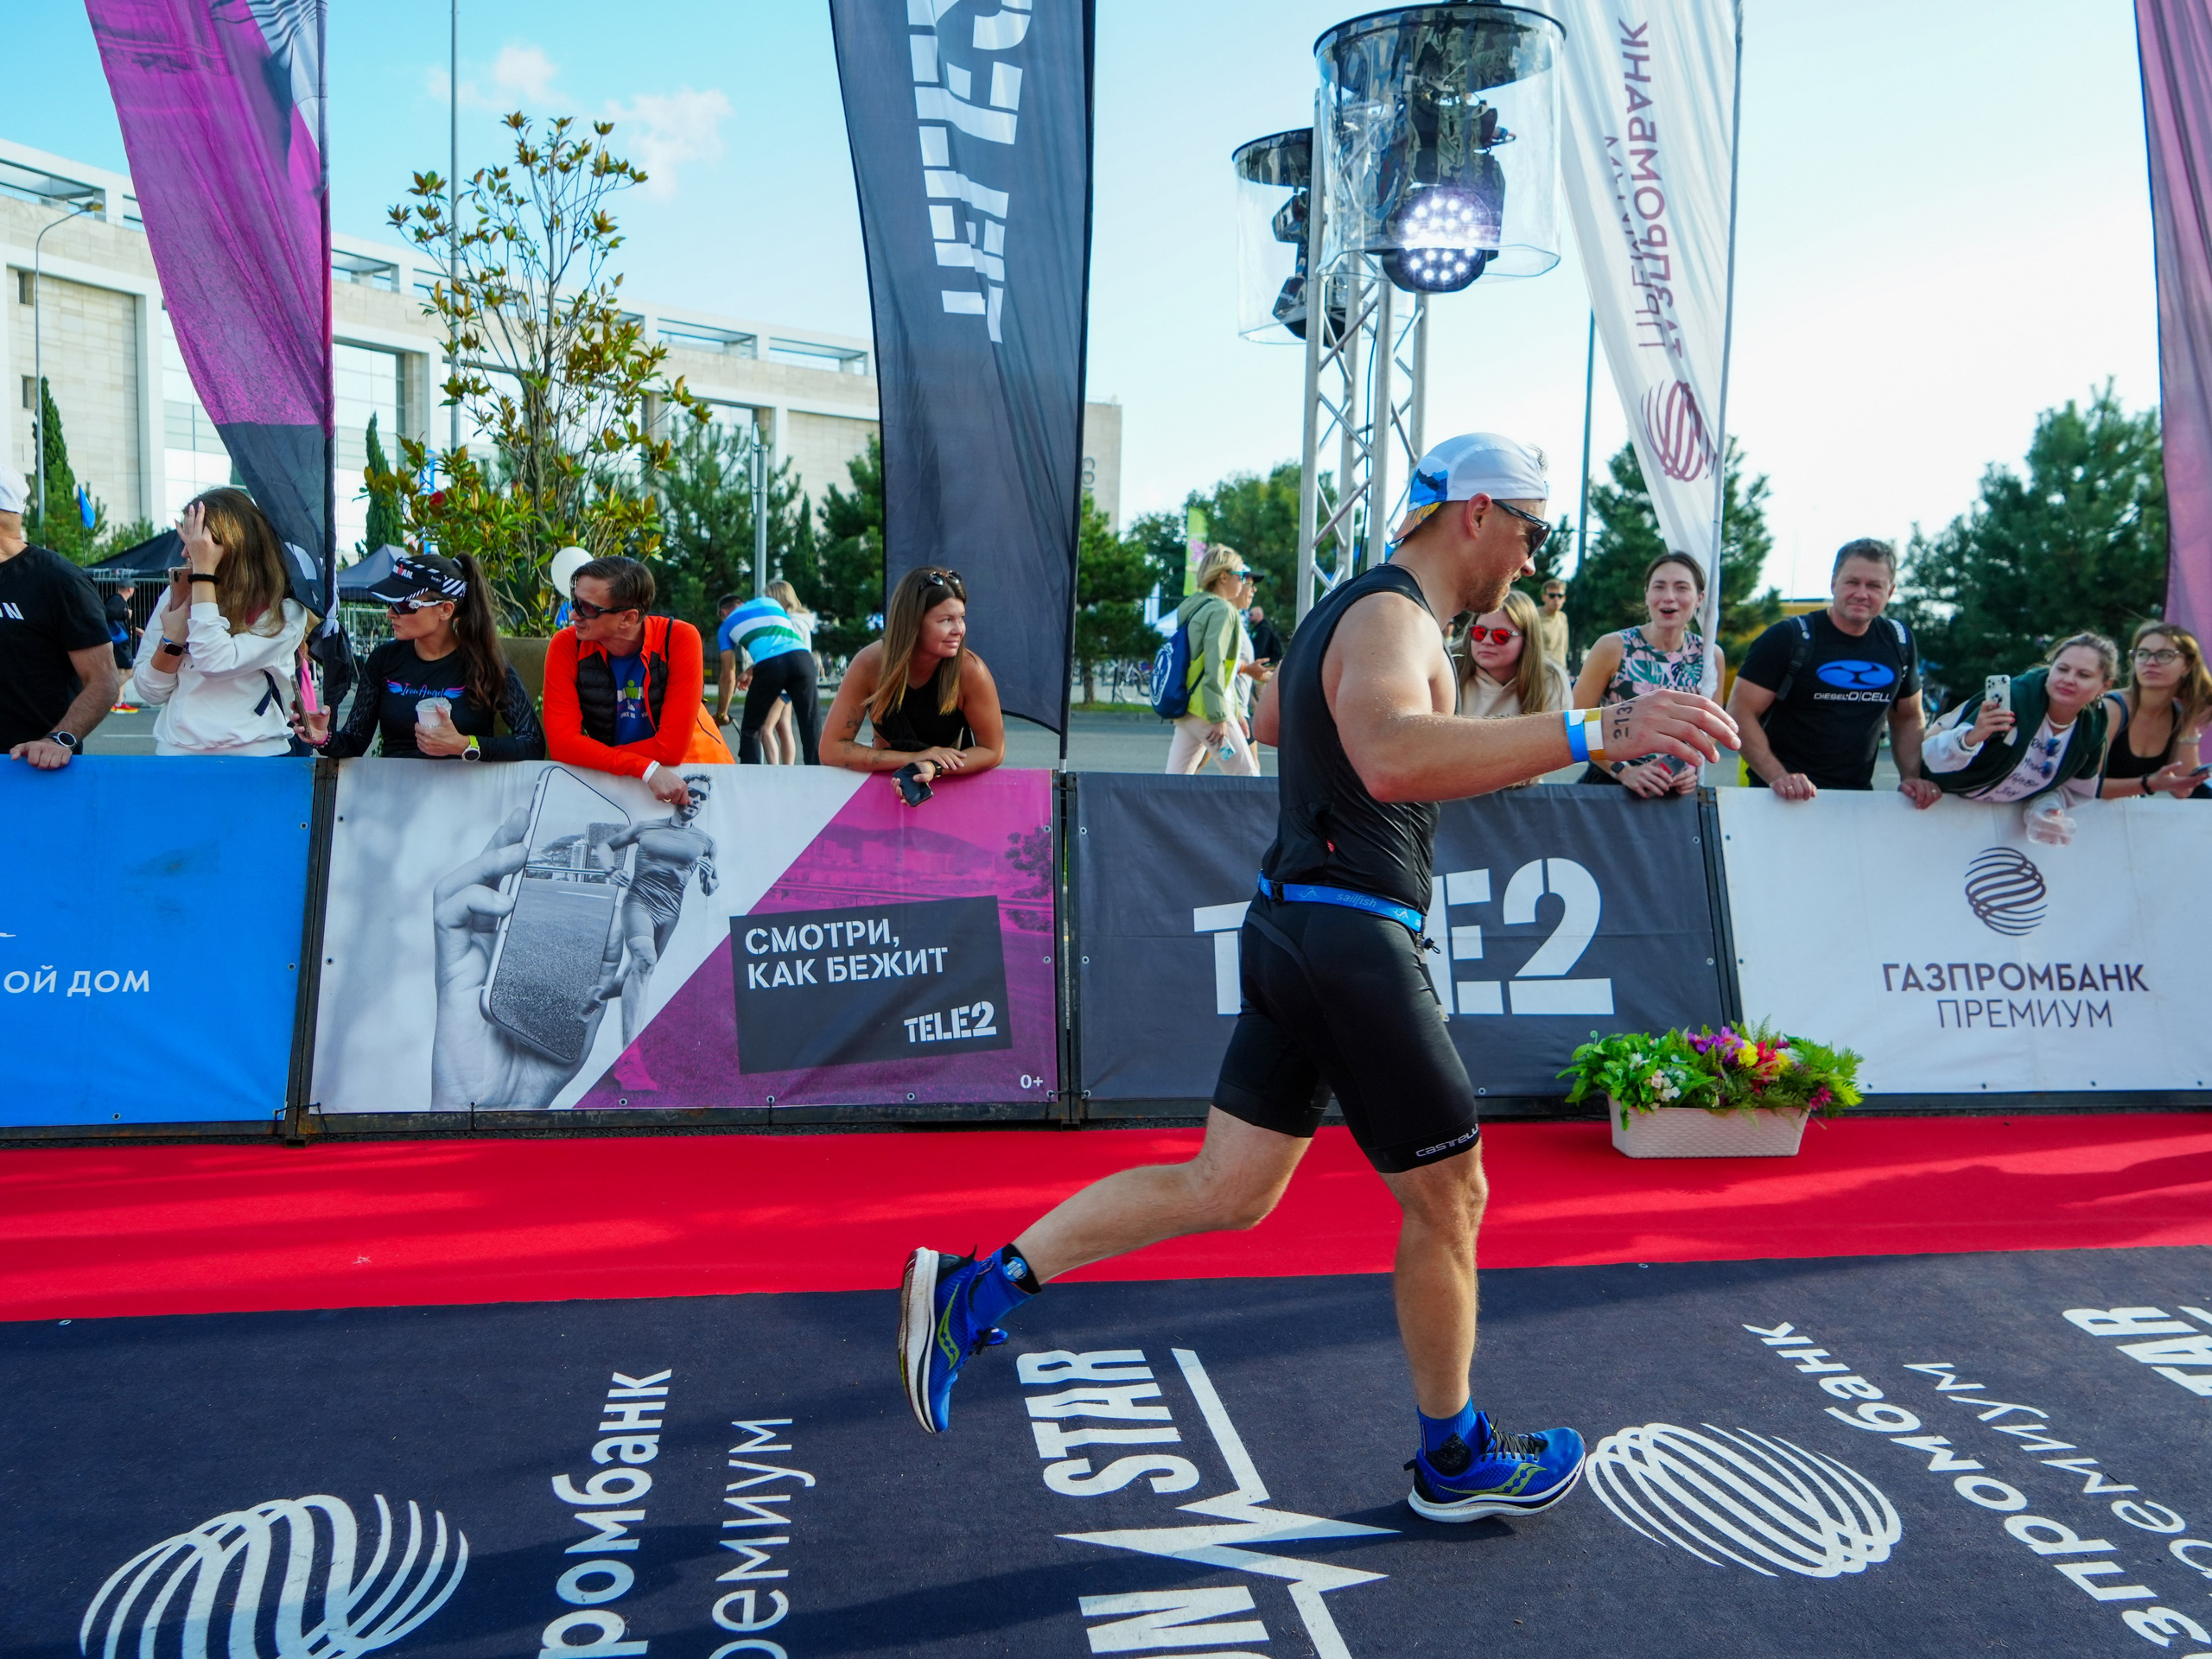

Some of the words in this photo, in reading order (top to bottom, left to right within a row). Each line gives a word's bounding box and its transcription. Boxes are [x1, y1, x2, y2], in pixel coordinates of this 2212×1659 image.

[1336, 893, 1377, 907] sailfish
[745, 918, 900, 956] СМОТРИ,
[747, 957, 818, 989] КАК
[827, 946, 949, 983] БЕЖИТ
[1882, 963, 2150, 992] ГАЗПРОМБАНК
[67, 969, 149, 997] ДОМ
[904, 1001, 997, 1043] TELE2
[1937, 999, 2113, 1028] ПРЕМИУМ
[1020, 1074, 1044, 1090] 0+
[1016, 1349, 1200, 1497] STAR
